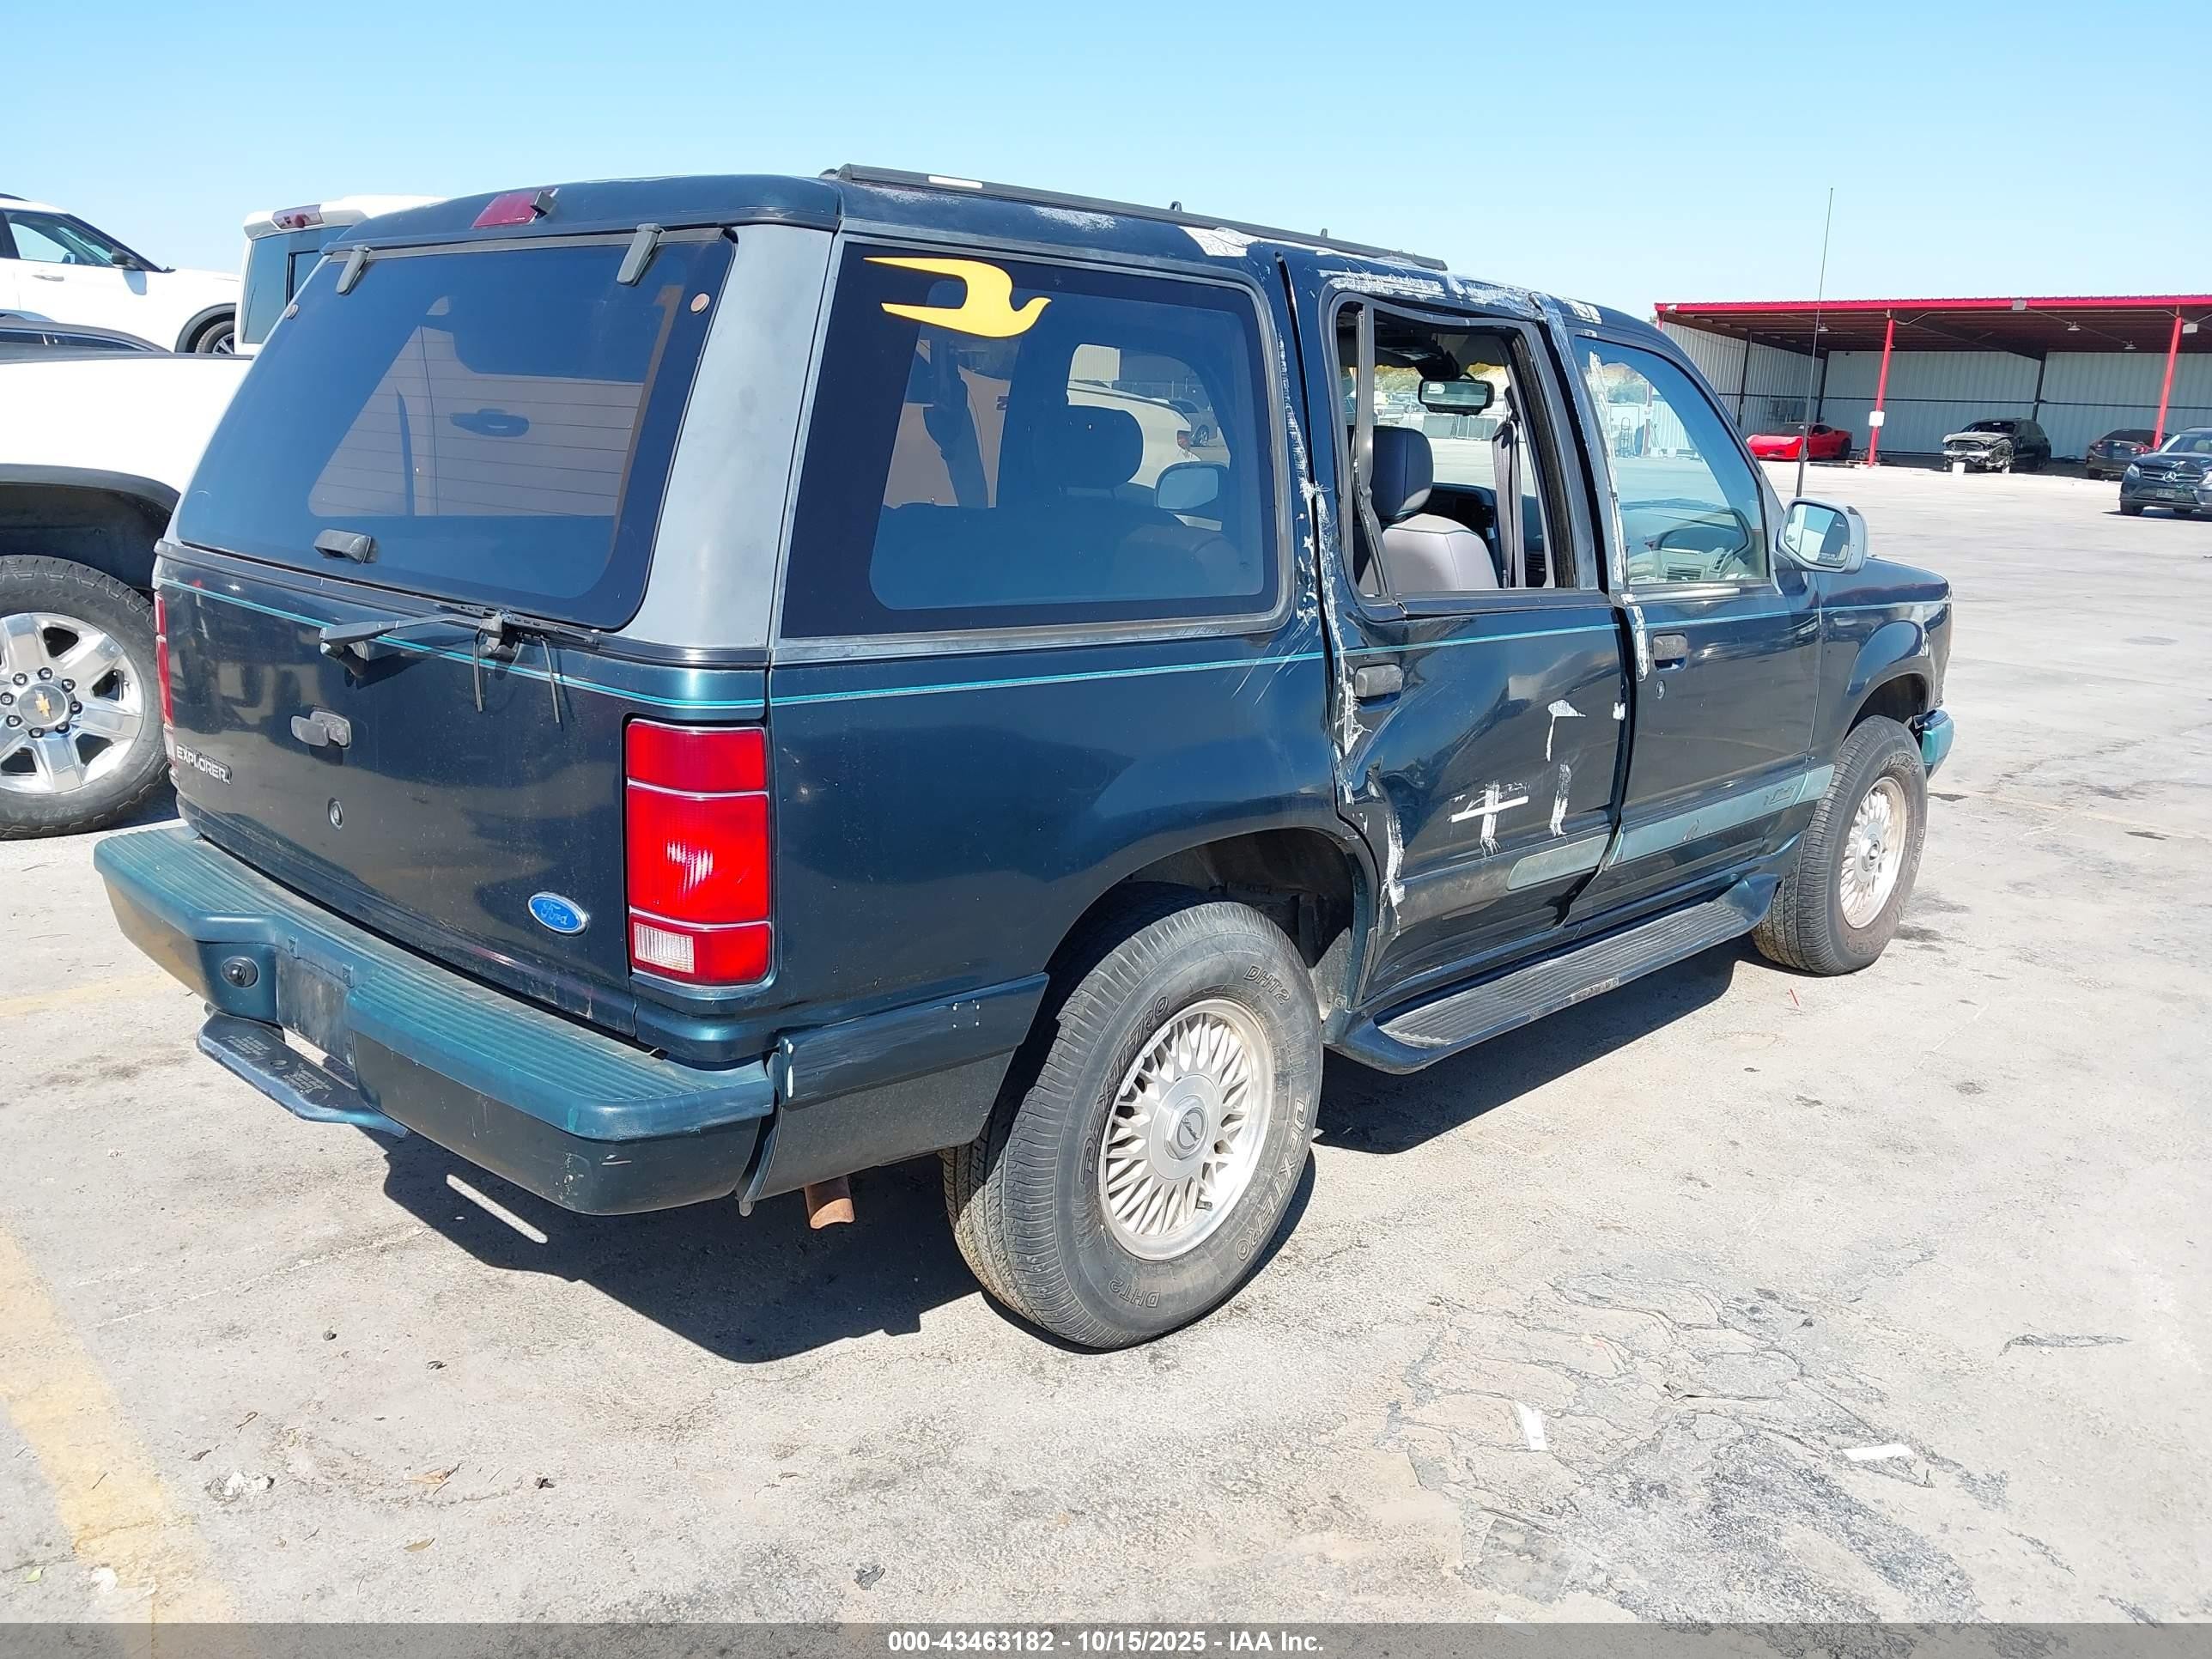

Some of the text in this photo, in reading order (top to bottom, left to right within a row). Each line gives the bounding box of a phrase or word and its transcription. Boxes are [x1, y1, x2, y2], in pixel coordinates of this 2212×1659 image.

[176, 744, 228, 783] EXPLORER
[1243, 963, 1291, 1006] DHT2
[1079, 995, 1170, 1185] DEXTERO
[1236, 1091, 1311, 1262] DEXTERO
[1109, 1273, 1161, 1309] DHT2
